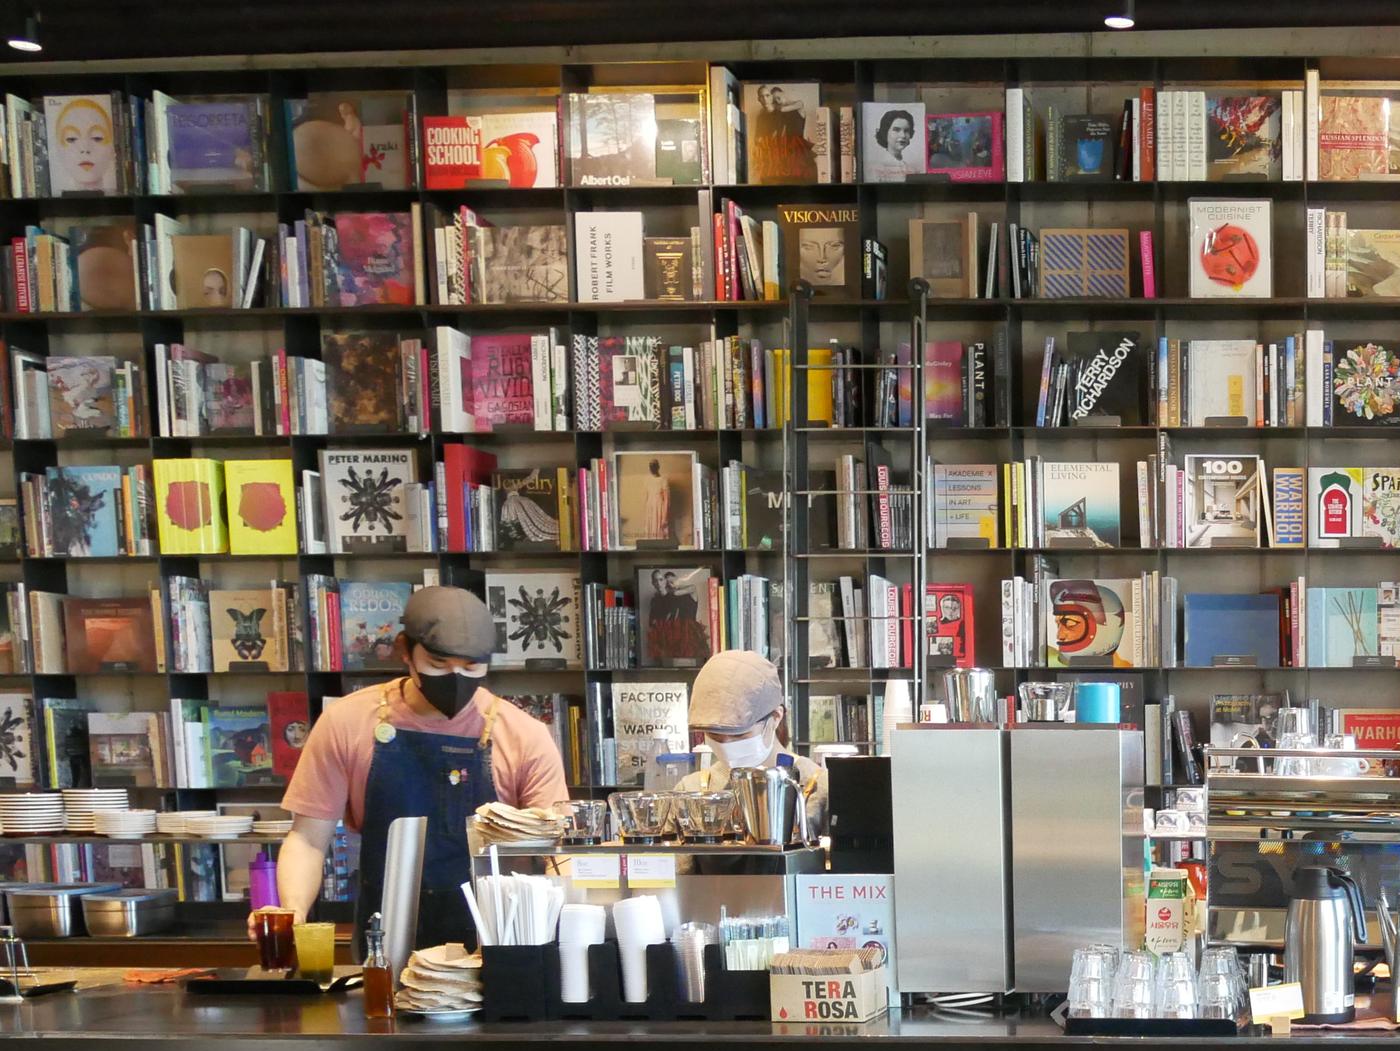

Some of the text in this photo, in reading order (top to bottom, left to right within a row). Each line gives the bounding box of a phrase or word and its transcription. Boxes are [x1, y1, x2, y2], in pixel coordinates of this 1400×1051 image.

[1145, 102, 1154, 148] LEONARDO
[426, 126, 479, 146] COOKING
[1320, 134, 1351, 142] RUSSIAN
[428, 145, 481, 166] SCHOOL
[581, 175, 612, 186] Albert
[784, 210, 858, 224] VISIONAIRE
[1196, 206, 1263, 214] MODERNIST
[1208, 213, 1252, 221] CUISINE
[16, 242, 24, 253] THE
[16, 254, 24, 280] LEBANESE
[590, 226, 598, 300] ROBERT FRANK
[605, 232, 614, 294] FILM WORKS
[974, 342, 985, 389] PLANT
[1074, 348, 1112, 395] TERRY
[432, 352, 440, 408] VISIONAIRE
[1072, 337, 1135, 421] RICHARDSON
[1347, 377, 1394, 388] PLANT
[328, 454, 408, 464] PETER MARINO
[1050, 464, 1112, 472] ELEMENTAL
[1202, 460, 1242, 474] 100
[495, 474, 553, 495] Jewelry
[1050, 472, 1088, 480] LIVING
[1276, 474, 1288, 544] WARHOL
[1288, 474, 1302, 544] WARHOL
[879, 498, 890, 548] BOURGEOIS
[888, 586, 896, 616] LOUISE
[1134, 582, 1142, 658] ELEMENTAL LIVING
[620, 692, 682, 703] FACTORY
[808, 886, 887, 900] THE MIX
[802, 981, 856, 1000] TERA
[804, 1000, 858, 1020] ROSA
